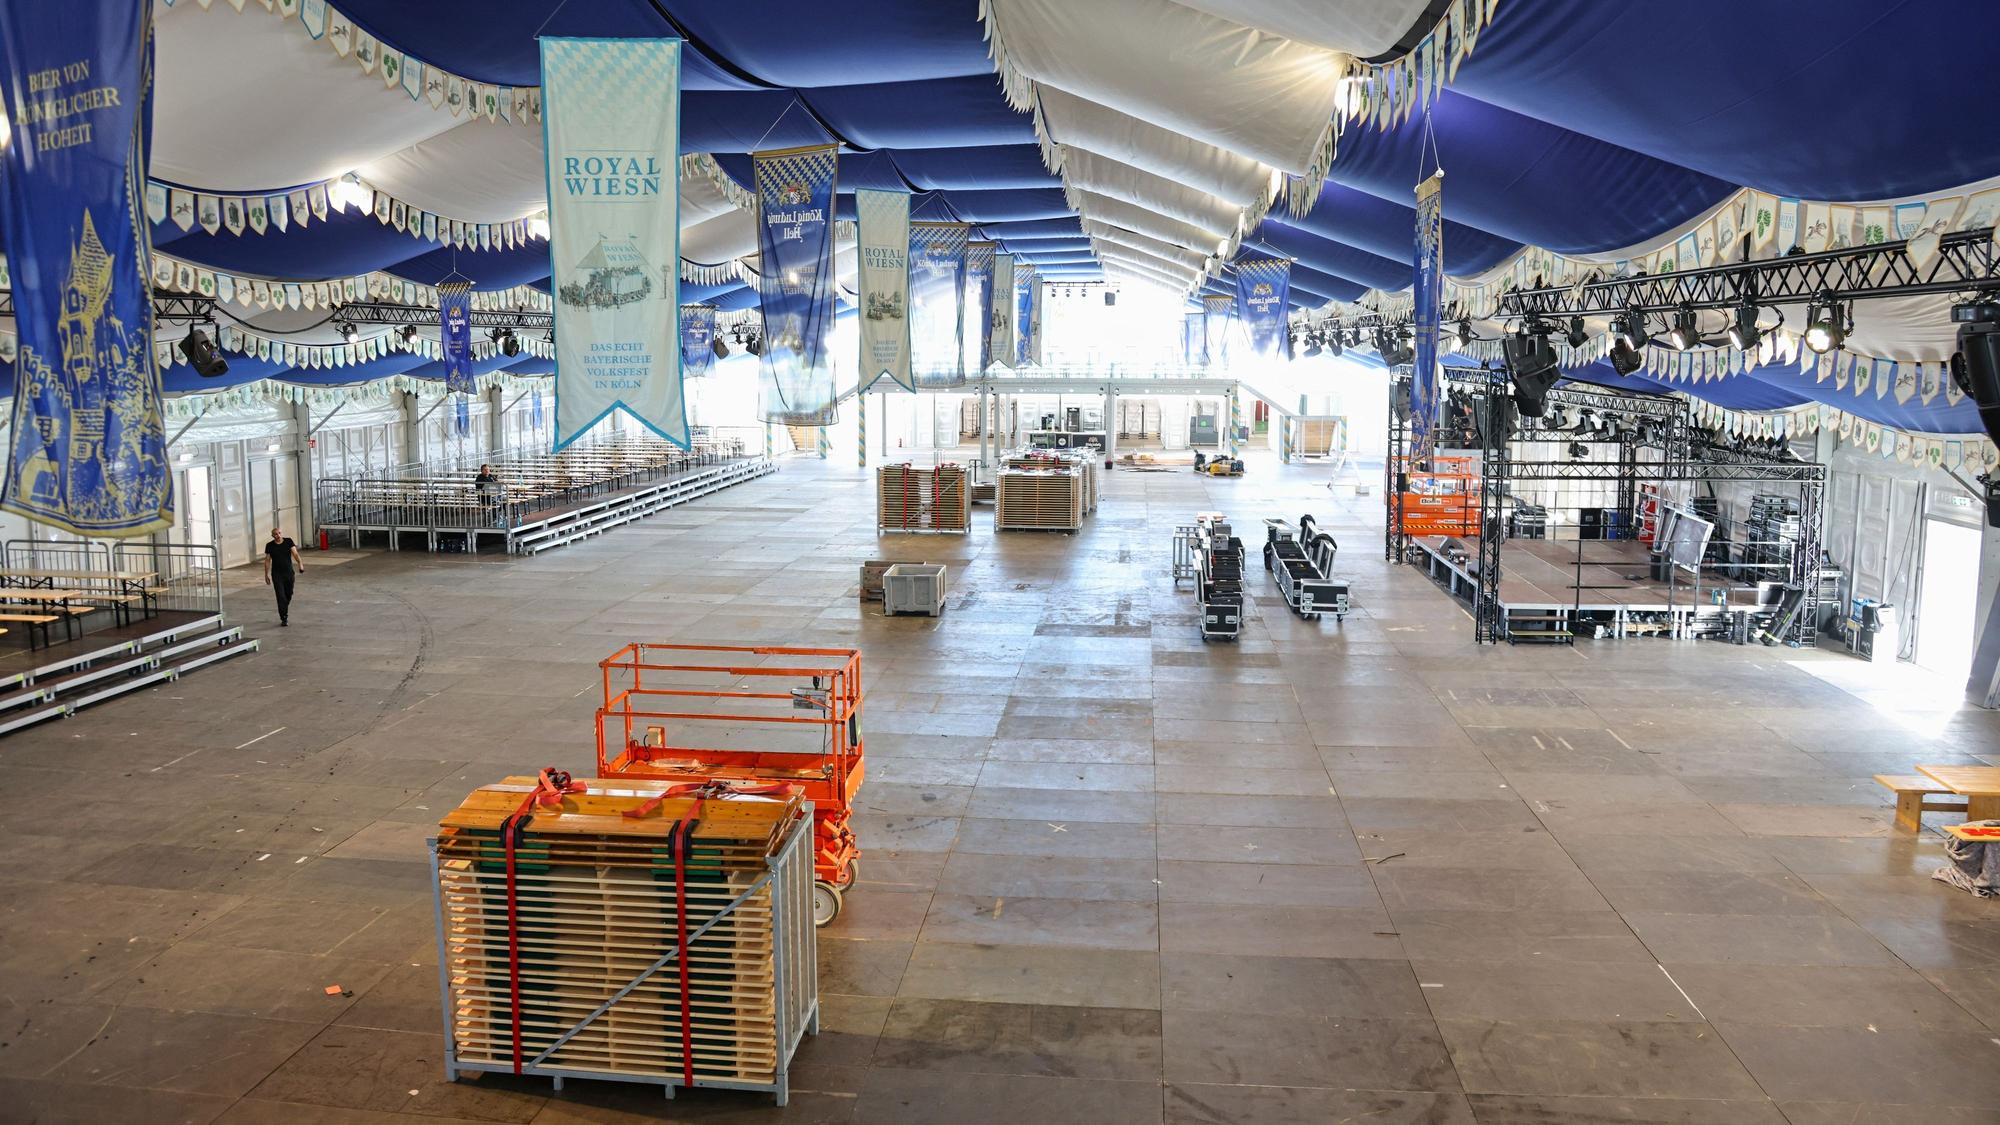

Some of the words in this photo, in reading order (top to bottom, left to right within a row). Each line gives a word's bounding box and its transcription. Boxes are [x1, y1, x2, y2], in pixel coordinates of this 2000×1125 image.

[28, 68, 61, 93] BIER
[63, 59, 90, 84] VON
[37, 122, 92, 152] HOHEIT
[564, 157, 661, 176] ROYAL
[564, 177, 660, 196] WIESN
[865, 247, 904, 258] ROYAL
[866, 258, 904, 269] WIESN
[590, 343, 612, 352] DAS
[614, 342, 644, 352] ECHT
[583, 355, 652, 364] BAYERISCHE
[587, 367, 649, 377] VOLKSFEST
[595, 380, 607, 389] IN
[611, 378, 641, 389] KÖLN
